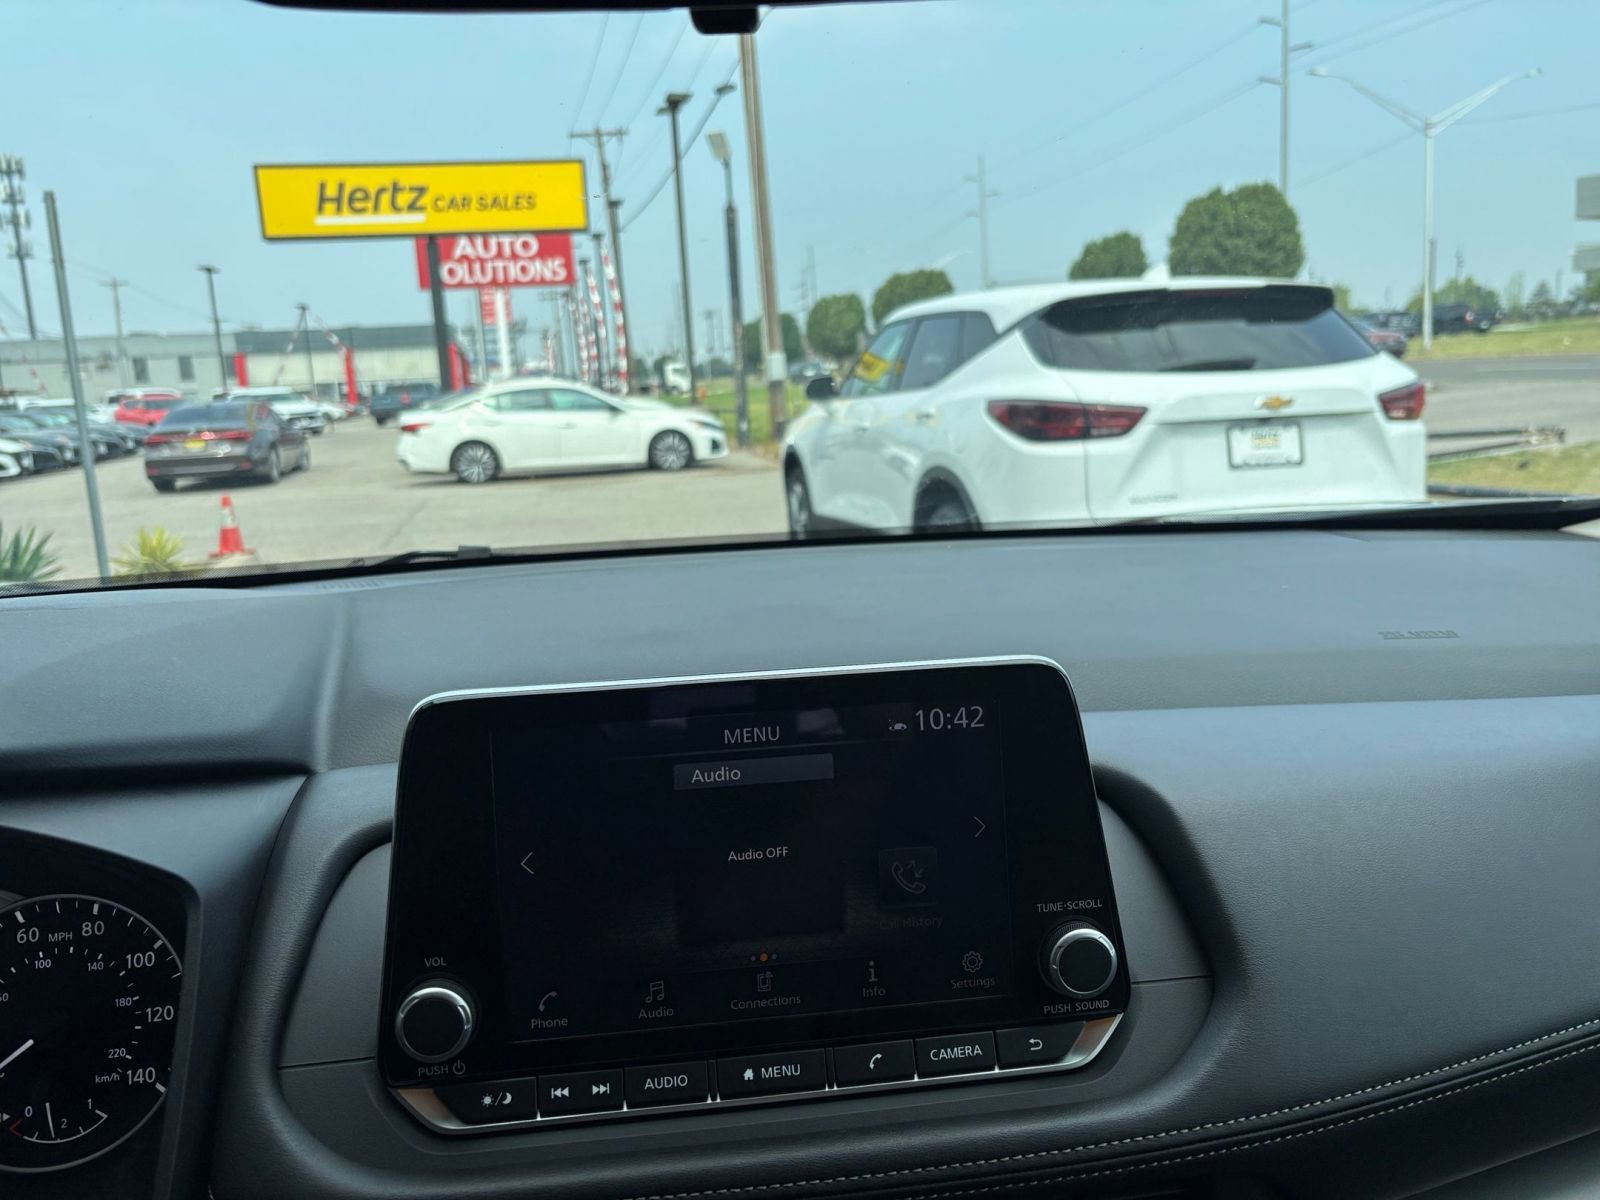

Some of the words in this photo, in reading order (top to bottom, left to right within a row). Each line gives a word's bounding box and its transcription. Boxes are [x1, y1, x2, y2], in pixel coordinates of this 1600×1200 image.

[316, 179, 429, 215] Hertz
[431, 195, 472, 213] CAR
[475, 192, 537, 212] SALES
[452, 235, 540, 261] AUTO
[438, 258, 568, 286] OLUTIONS
[914, 705, 985, 732] 10:42
[723, 726, 781, 744] MENU
[691, 766, 741, 784] Audio
[727, 849, 763, 862] Audio
[766, 846, 790, 859] OFF
[16, 927, 40, 944] 60
[48, 931, 73, 942] MPH
[81, 921, 105, 938] 80
[34, 958, 52, 970] 100
[87, 961, 104, 972] 140
[125, 951, 156, 969] 100
[424, 957, 447, 968] VOL
[951, 976, 996, 991] Settings
[862, 986, 886, 998] Info
[115, 996, 133, 1008] 180
[730, 995, 801, 1011] Connections
[1043, 1003, 1072, 1015] PUSH
[1075, 1000, 1110, 1012] SOUND
[145, 1005, 175, 1023] 120
[638, 1006, 675, 1019] Audio
[530, 1017, 569, 1030] Phone
[108, 1047, 127, 1059] 220
[930, 1044, 983, 1062] CAMERA
[95, 1073, 120, 1084] km/h
[126, 1067, 157, 1085] 140
[417, 1065, 449, 1078] PUSH
[761, 1063, 801, 1080] MENU
[644, 1073, 689, 1090] AUDIO
[24, 1105, 34, 1118] 0
[87, 1098, 93, 1110] 1
